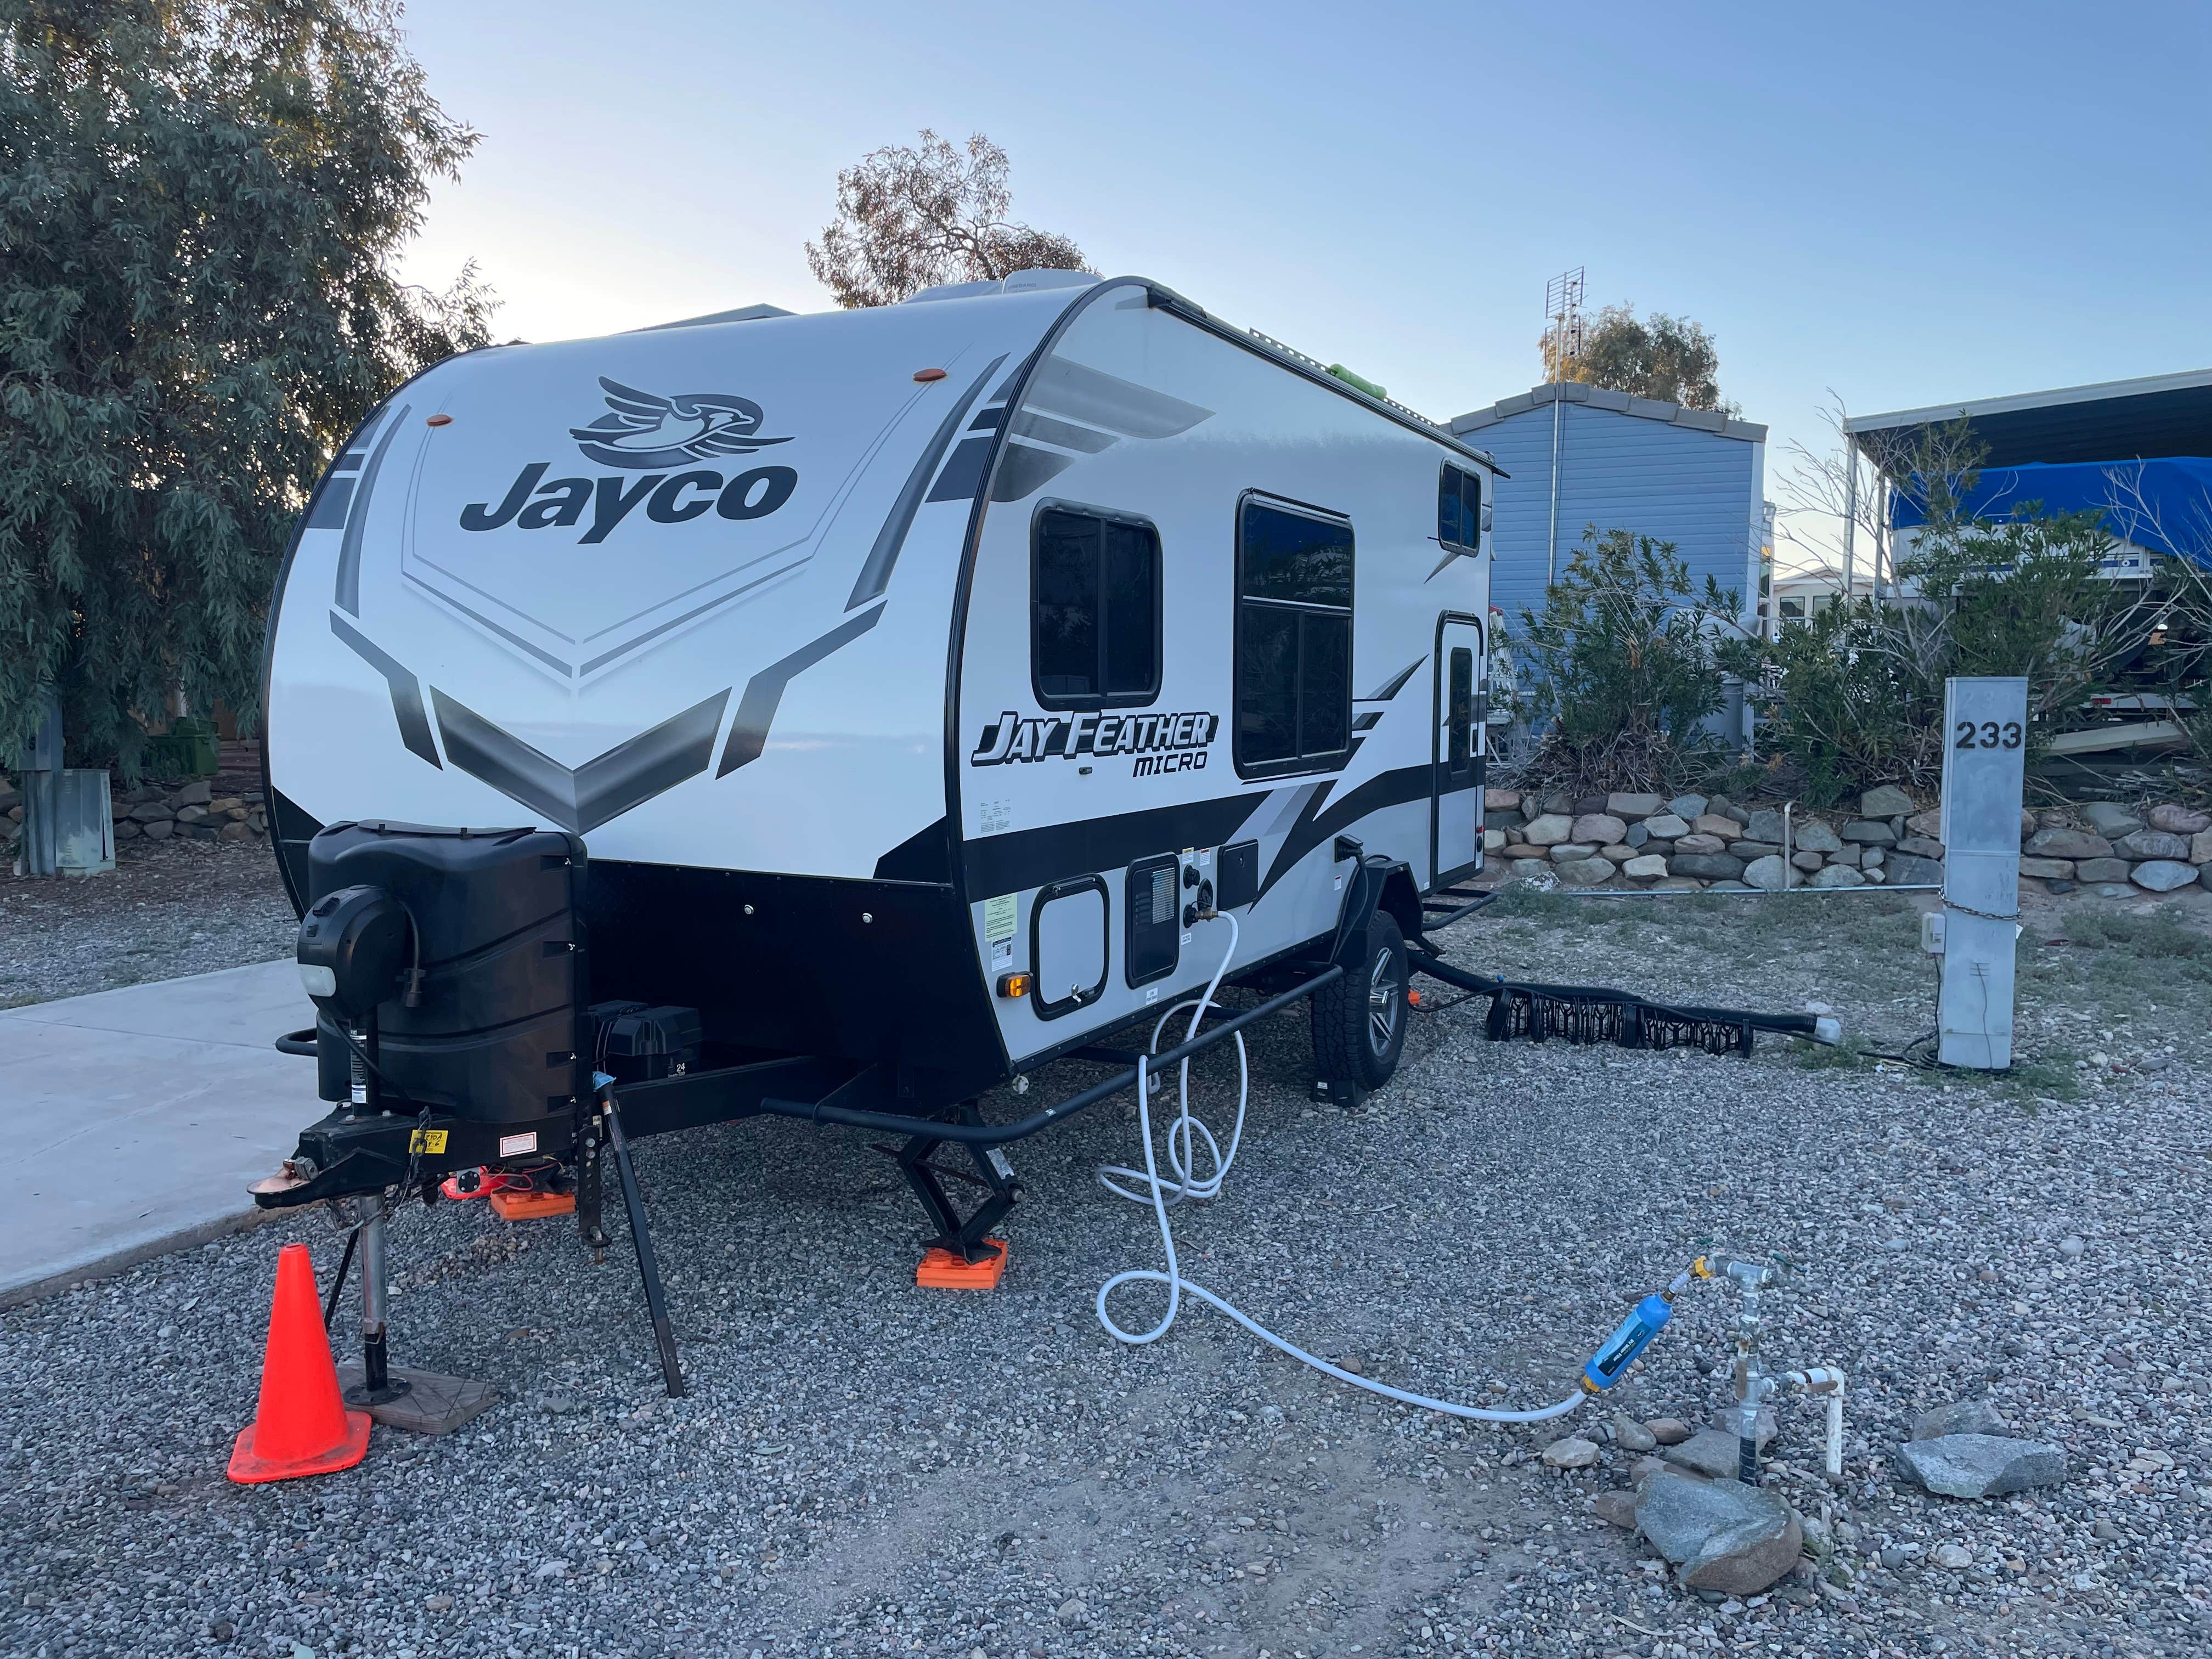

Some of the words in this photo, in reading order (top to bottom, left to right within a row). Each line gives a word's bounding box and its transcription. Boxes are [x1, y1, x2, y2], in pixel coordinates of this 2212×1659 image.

[459, 461, 798, 545] Jayco
[970, 711, 1060, 767] JAY
[1063, 710, 1211, 759] FEATHER
[1956, 721, 2022, 749] 233
[1132, 751, 1207, 777] MICRO
[676, 1062, 685, 1072] 24
